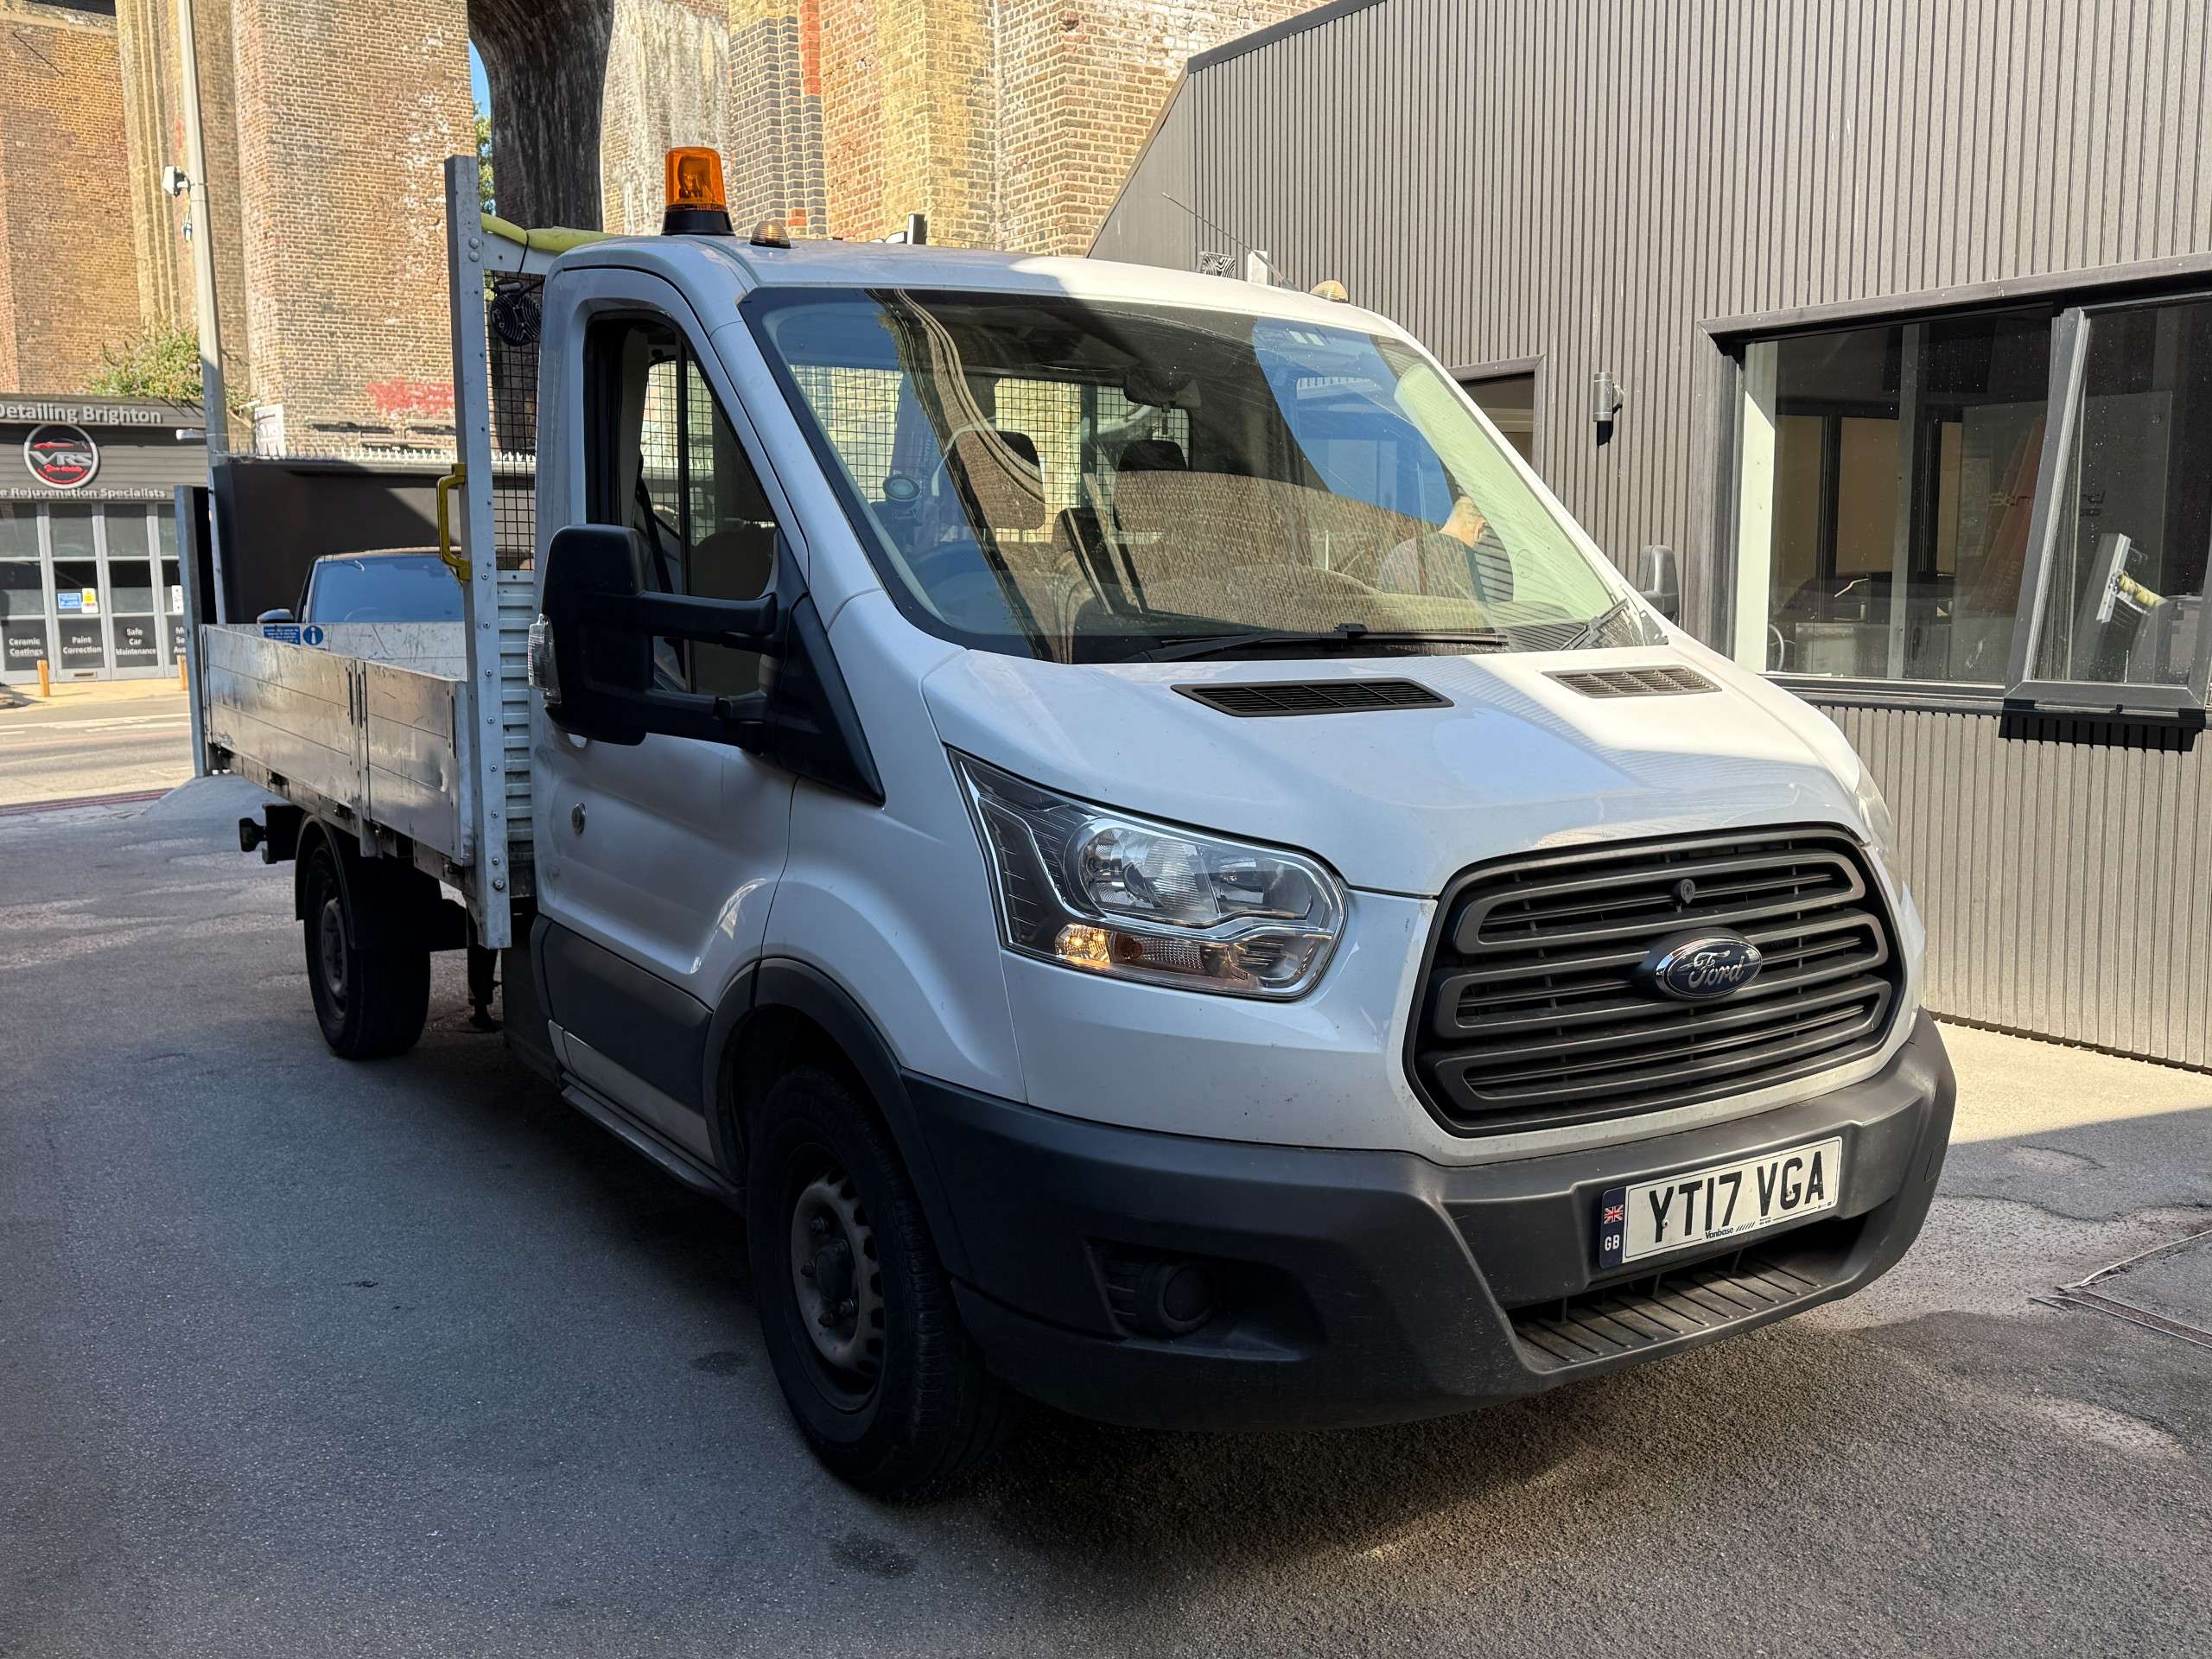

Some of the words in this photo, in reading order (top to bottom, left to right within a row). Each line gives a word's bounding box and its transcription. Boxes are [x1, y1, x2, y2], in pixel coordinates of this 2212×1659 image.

[83, 405, 162, 424] Brighton
[29, 451, 92, 466] VRS
[10, 487, 98, 499] Rejuvenation
[100, 487, 166, 499] Specialists
[72, 635, 92, 644] Paint
[62, 645, 103, 654] Correction
[1680, 950, 1745, 988] Ford
[1648, 1170, 1743, 1243] YT17
[1756, 1150, 1825, 1217] VGA
[1704, 1225, 1735, 1240] Vanbase
[1604, 1233, 1620, 1252] GB
